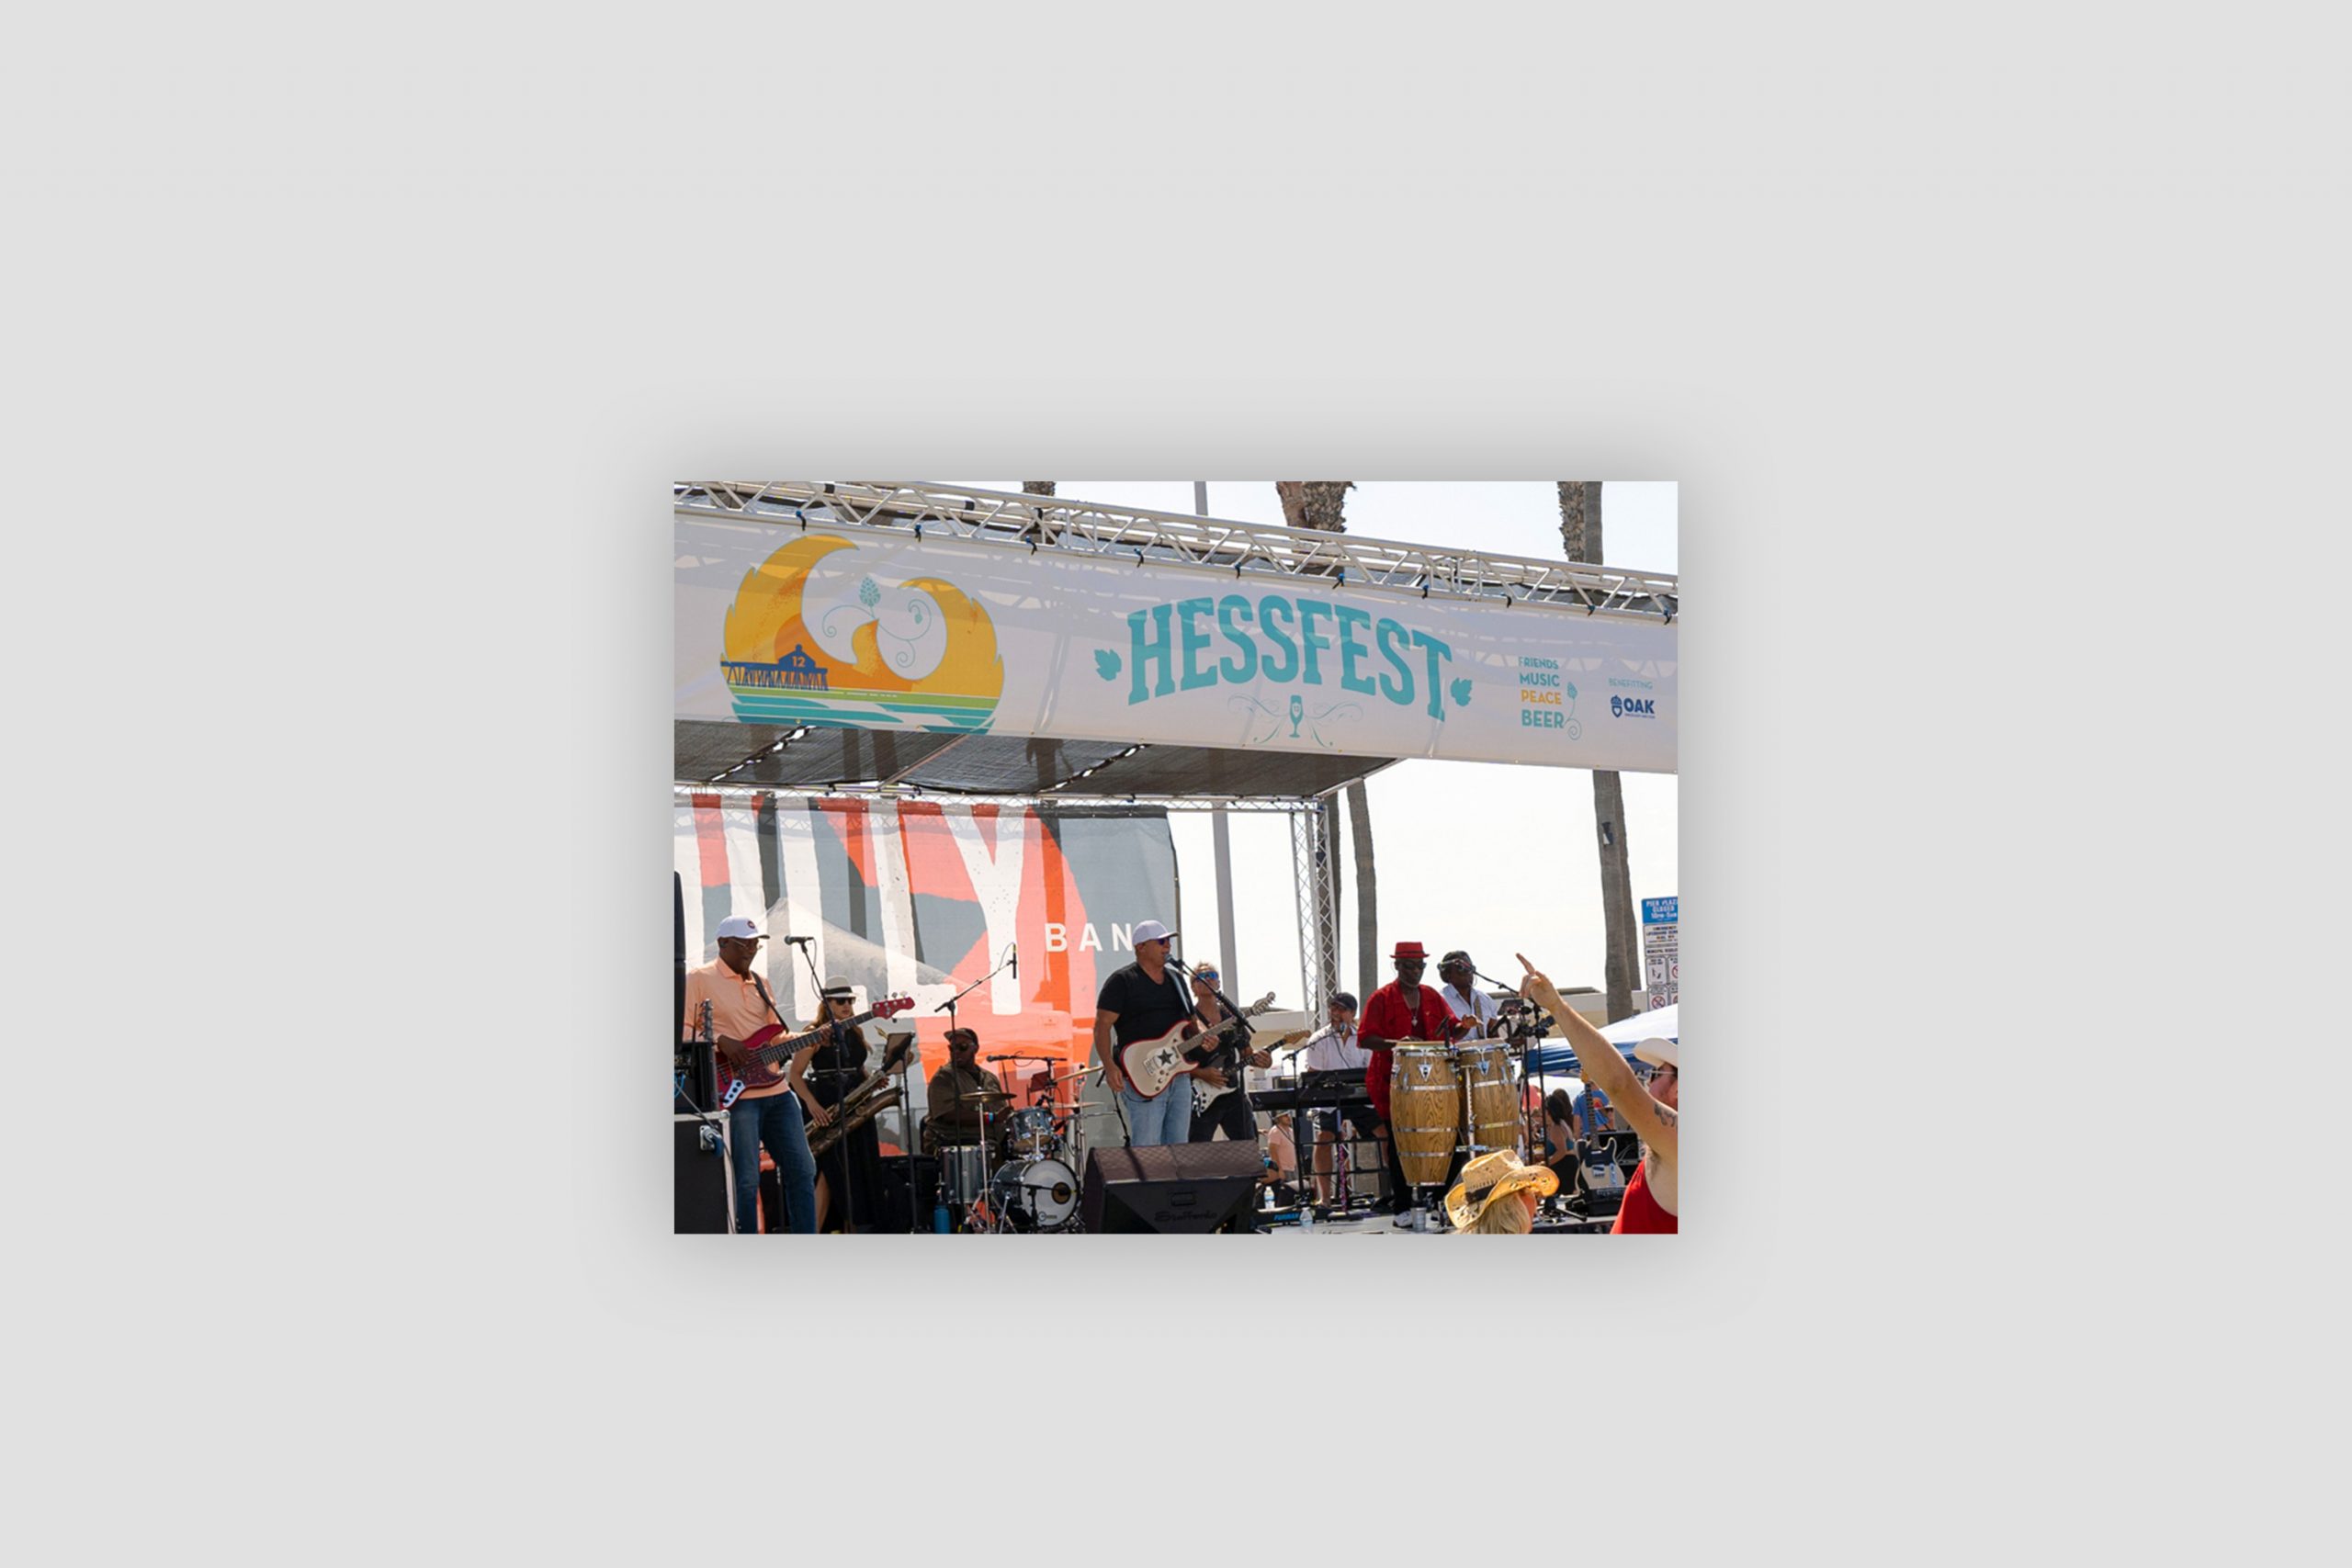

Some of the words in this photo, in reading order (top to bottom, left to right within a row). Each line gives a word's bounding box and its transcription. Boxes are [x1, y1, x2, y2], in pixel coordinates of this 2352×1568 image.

[792, 656, 806, 668] 12
[1127, 593, 1453, 722] HESSFEST
[1518, 656, 1559, 670] FRIENDS
[1519, 672, 1560, 687] MUSIC
[1608, 677, 1654, 690] BENEFITTING
[1521, 689, 1562, 705] PEACE
[1623, 697, 1656, 714] OAK
[1521, 709, 1564, 729] BEER
